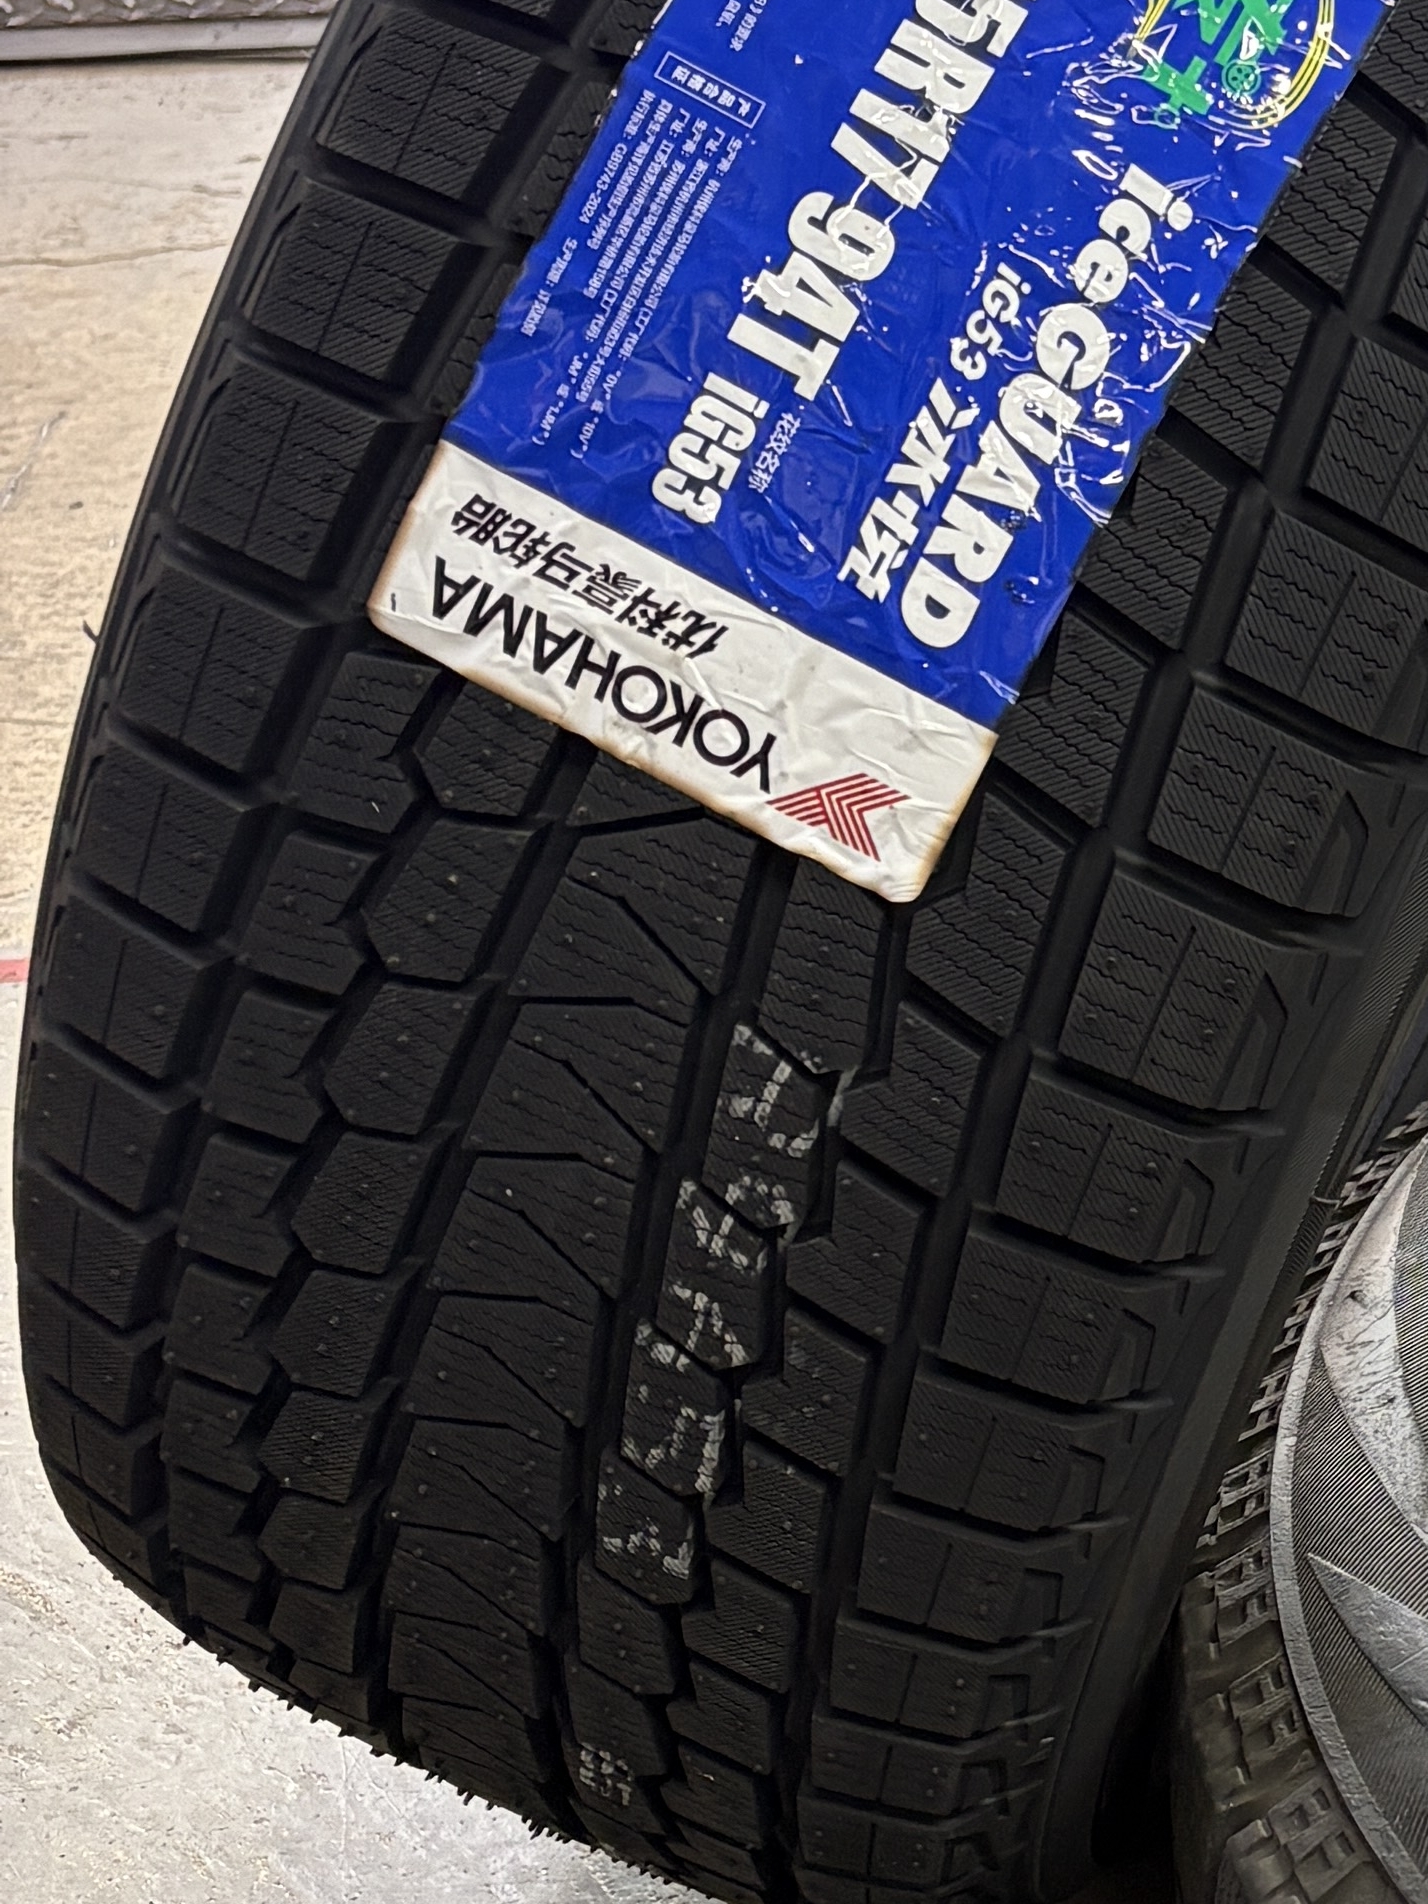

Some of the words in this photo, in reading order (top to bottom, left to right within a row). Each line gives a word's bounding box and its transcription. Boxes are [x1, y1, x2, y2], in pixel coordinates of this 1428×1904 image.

[669, 62, 753, 119] 产品合格证
[727, 192, 894, 400] 94T
[950, 262, 1030, 379] iG53
[652, 372, 769, 522] iG53
[749, 413, 799, 491] 花纹名称
[837, 378, 979, 601] 冰悦
[452, 494, 726, 657] 优科豪马轮胎
[433, 557, 775, 791] YOKOHAMA
